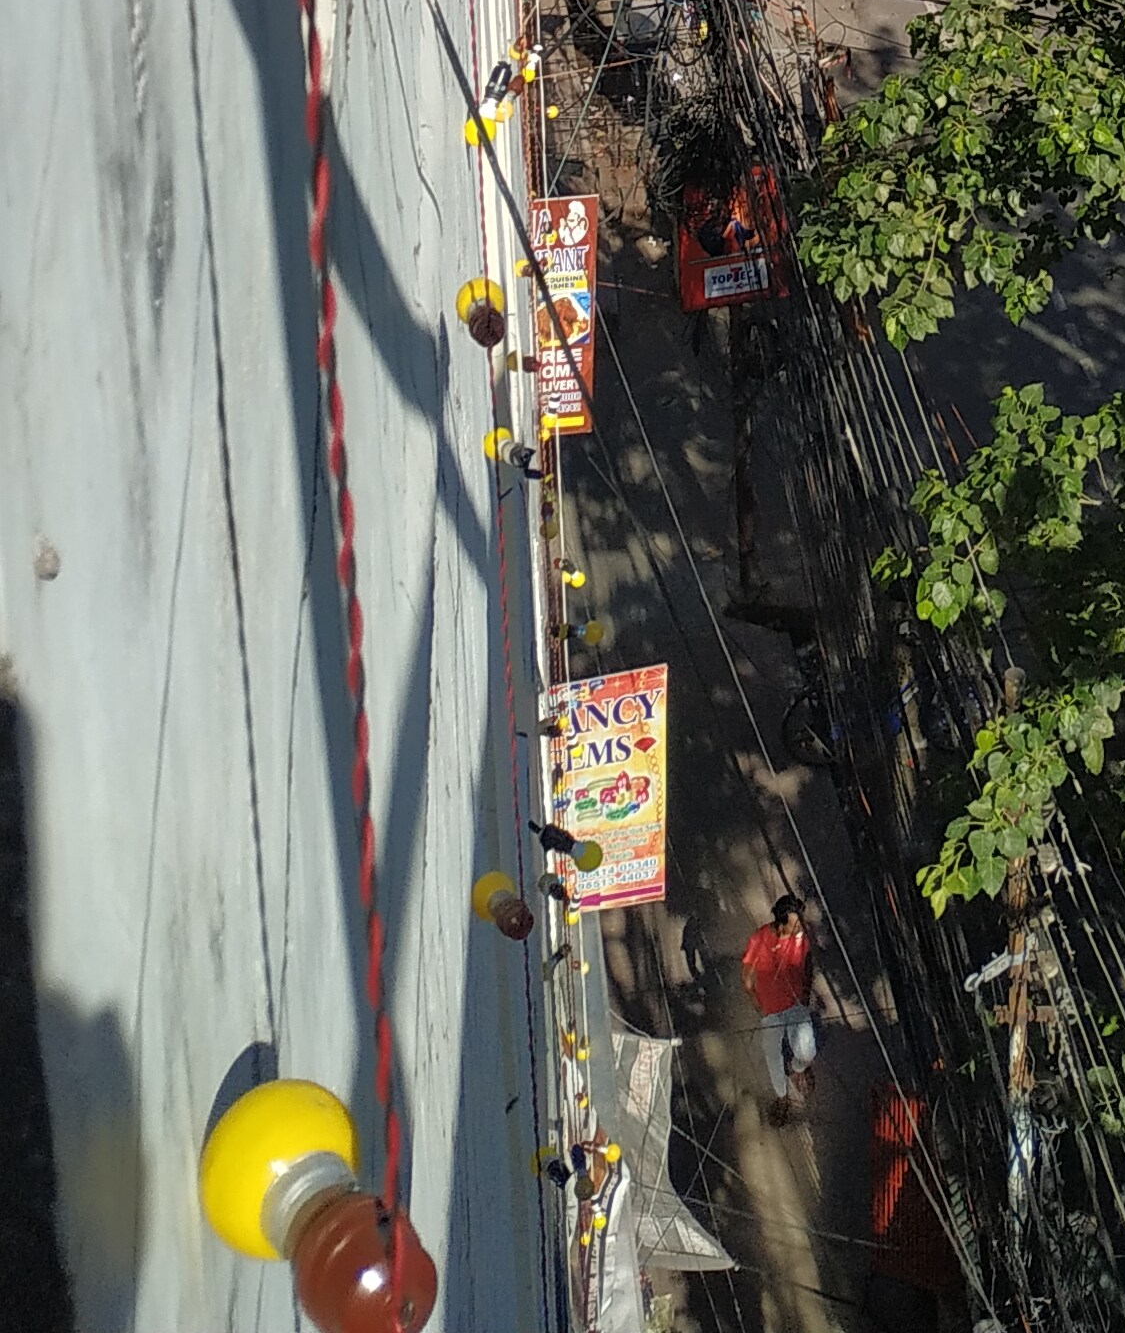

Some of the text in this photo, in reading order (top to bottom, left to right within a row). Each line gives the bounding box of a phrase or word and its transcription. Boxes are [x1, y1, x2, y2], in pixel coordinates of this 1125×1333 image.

[539, 347, 583, 364] REE
[567, 689, 664, 737] ANCY
[564, 734, 632, 773] EMS
